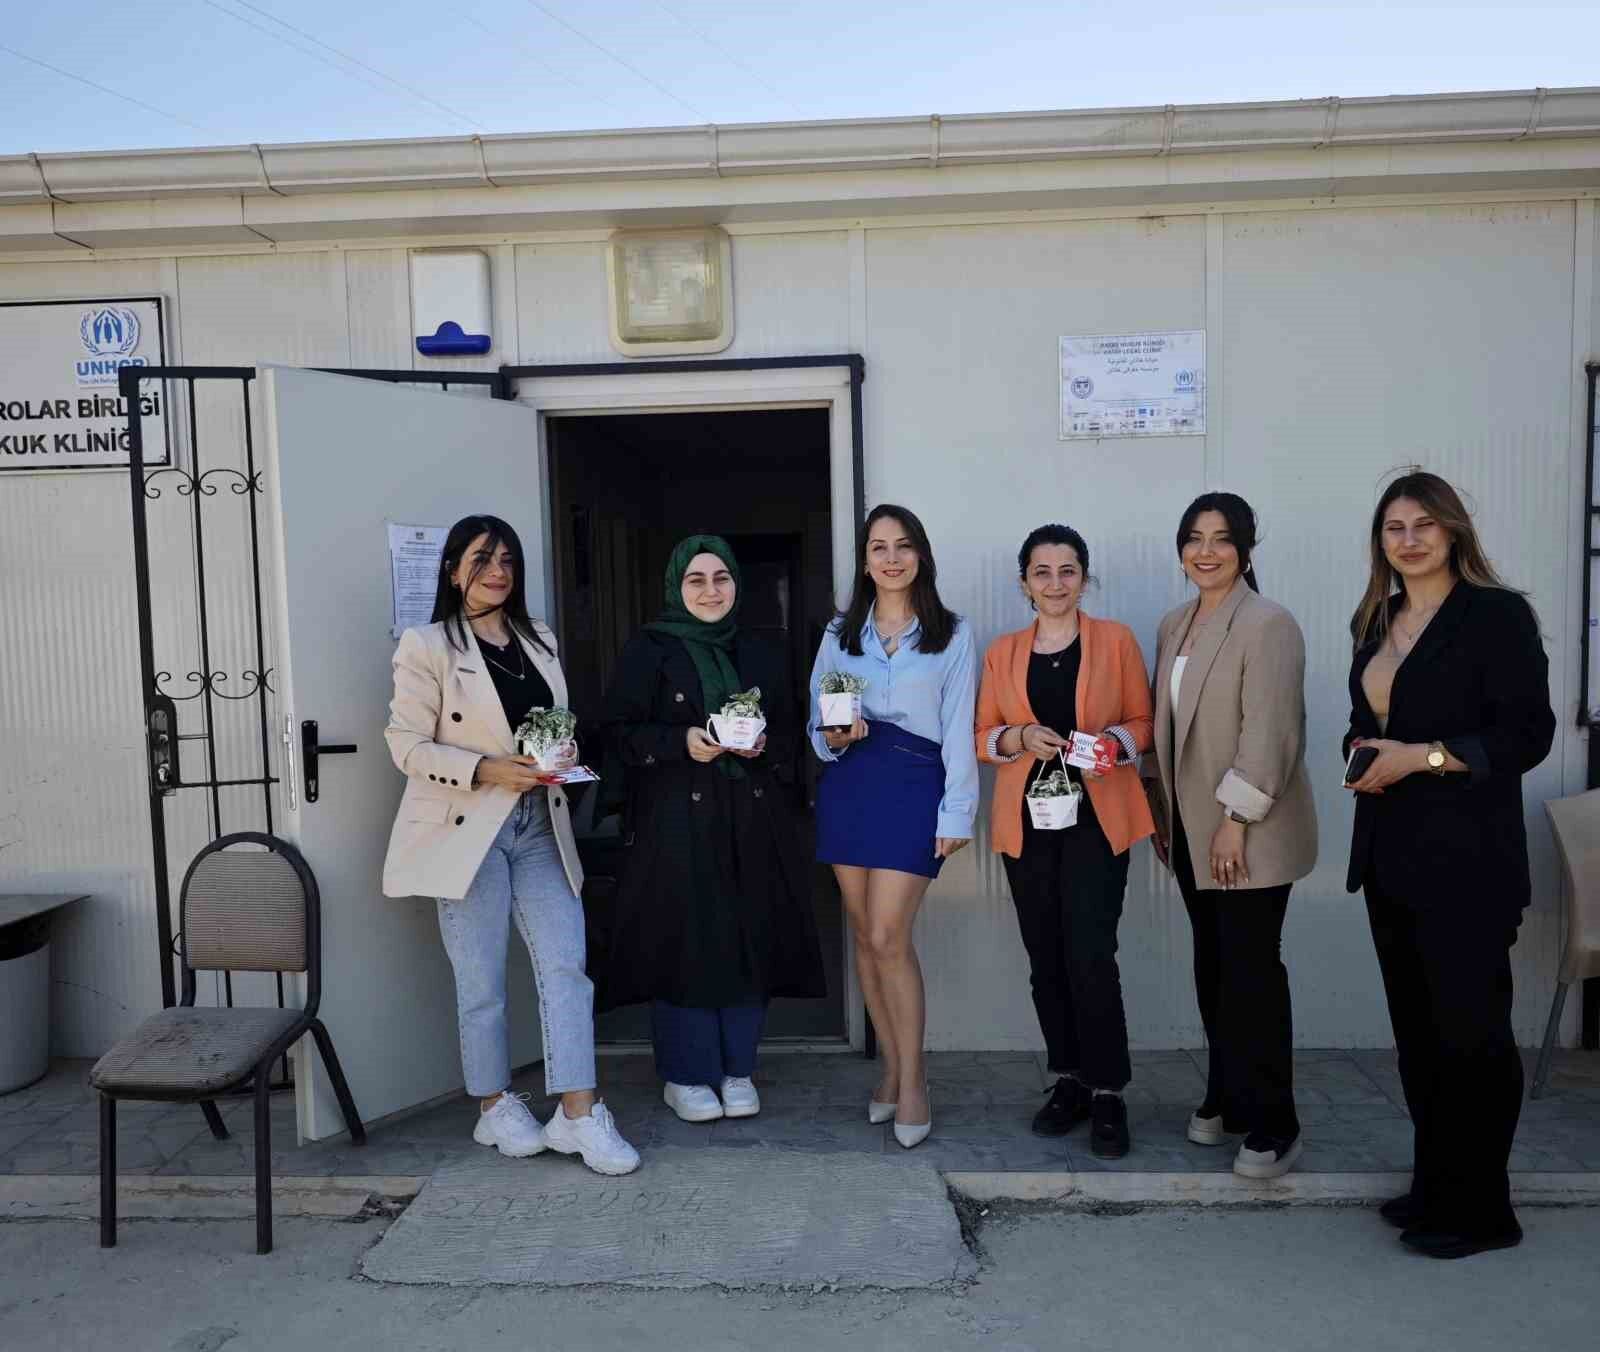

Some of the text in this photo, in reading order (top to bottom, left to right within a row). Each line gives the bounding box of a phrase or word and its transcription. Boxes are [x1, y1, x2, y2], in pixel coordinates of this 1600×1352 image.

[76, 359, 144, 376] UNHCR
[77, 392, 160, 418] BİRLĞİ
[54, 427, 132, 453] KLİNİĞ
